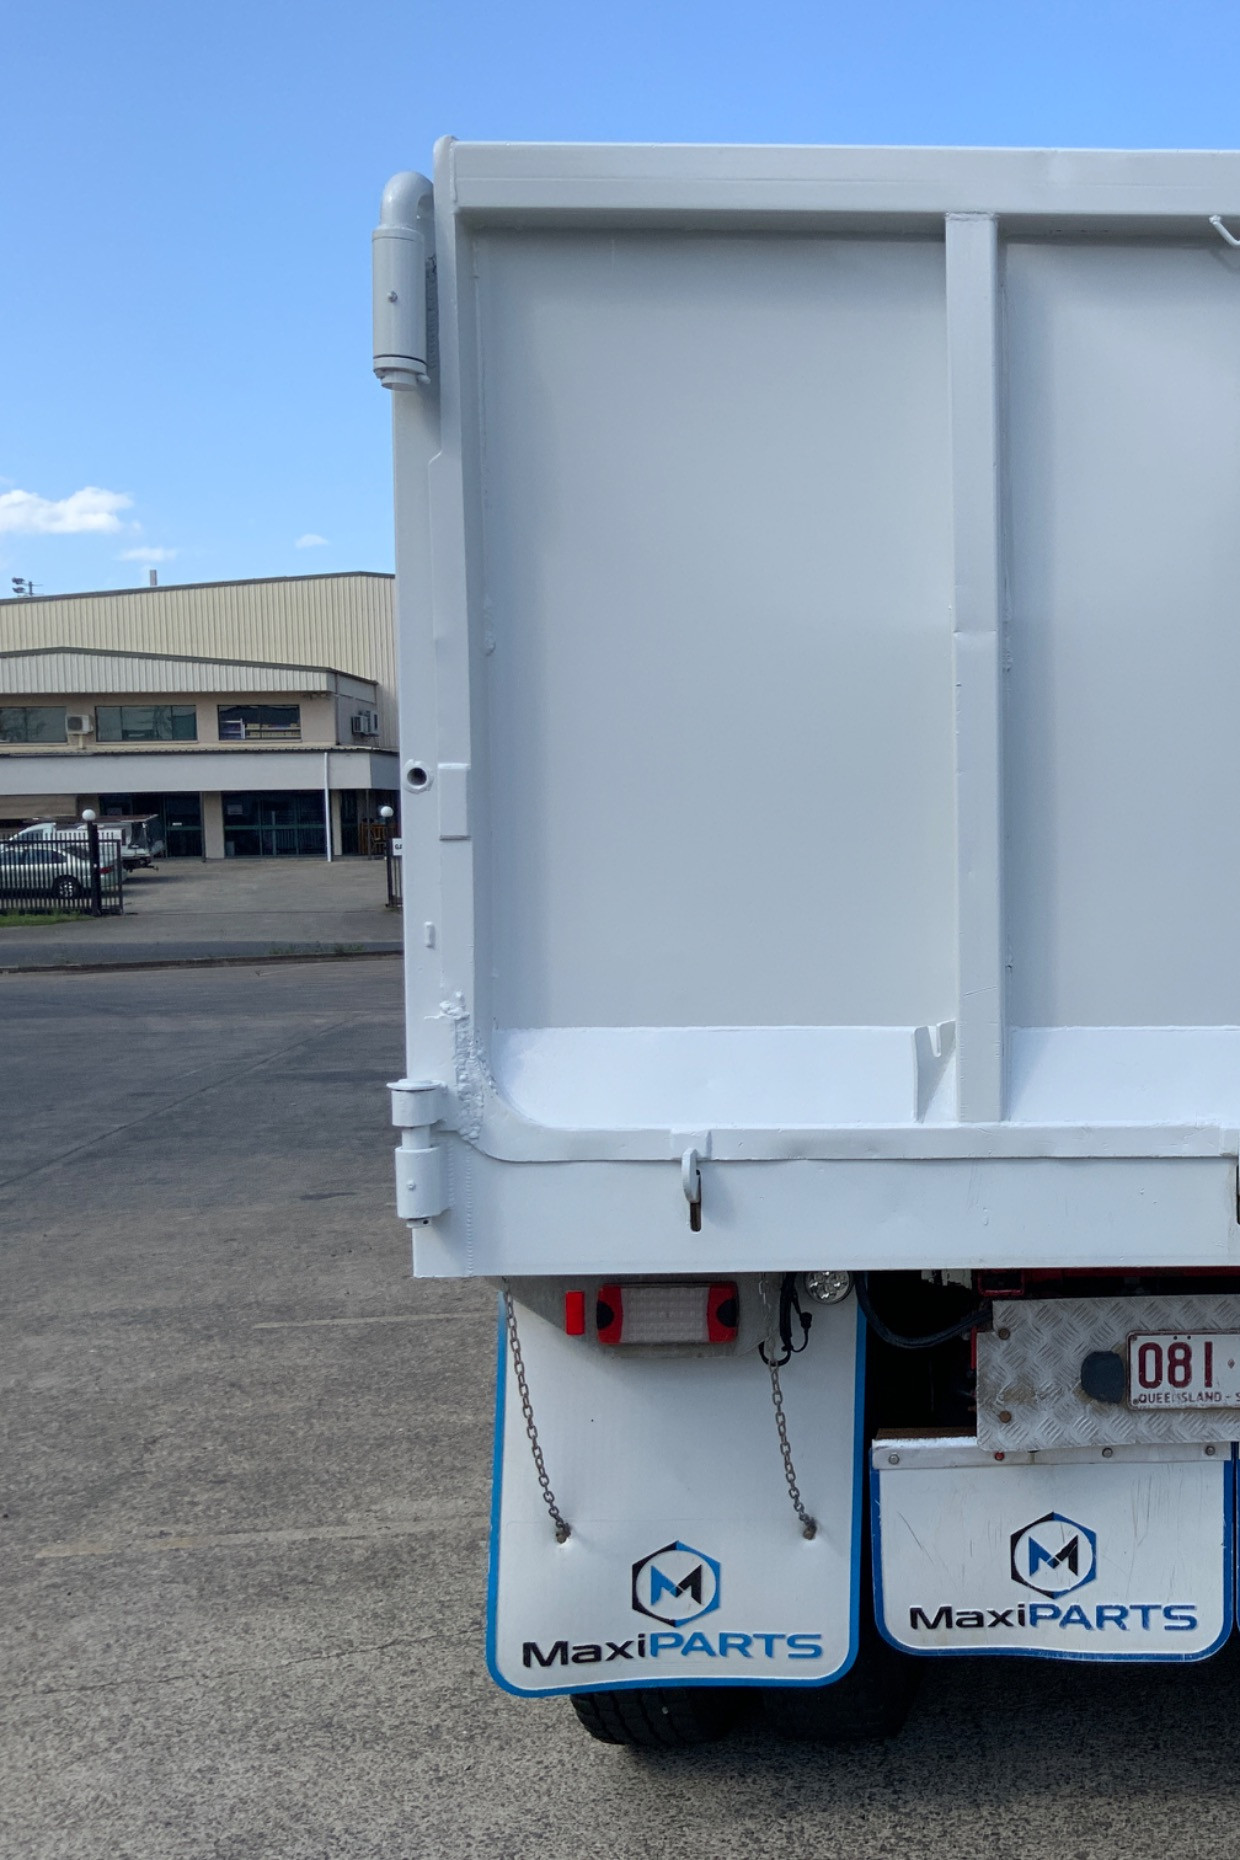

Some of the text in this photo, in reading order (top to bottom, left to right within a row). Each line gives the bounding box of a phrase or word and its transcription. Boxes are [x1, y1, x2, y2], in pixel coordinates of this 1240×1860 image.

[1138, 1341, 1213, 1389] 081
[1138, 1391, 1222, 1404] QUEENSLAND
[909, 1603, 1198, 1631] MaxiPARTS
[522, 1631, 823, 1668] MaxiPARTS
